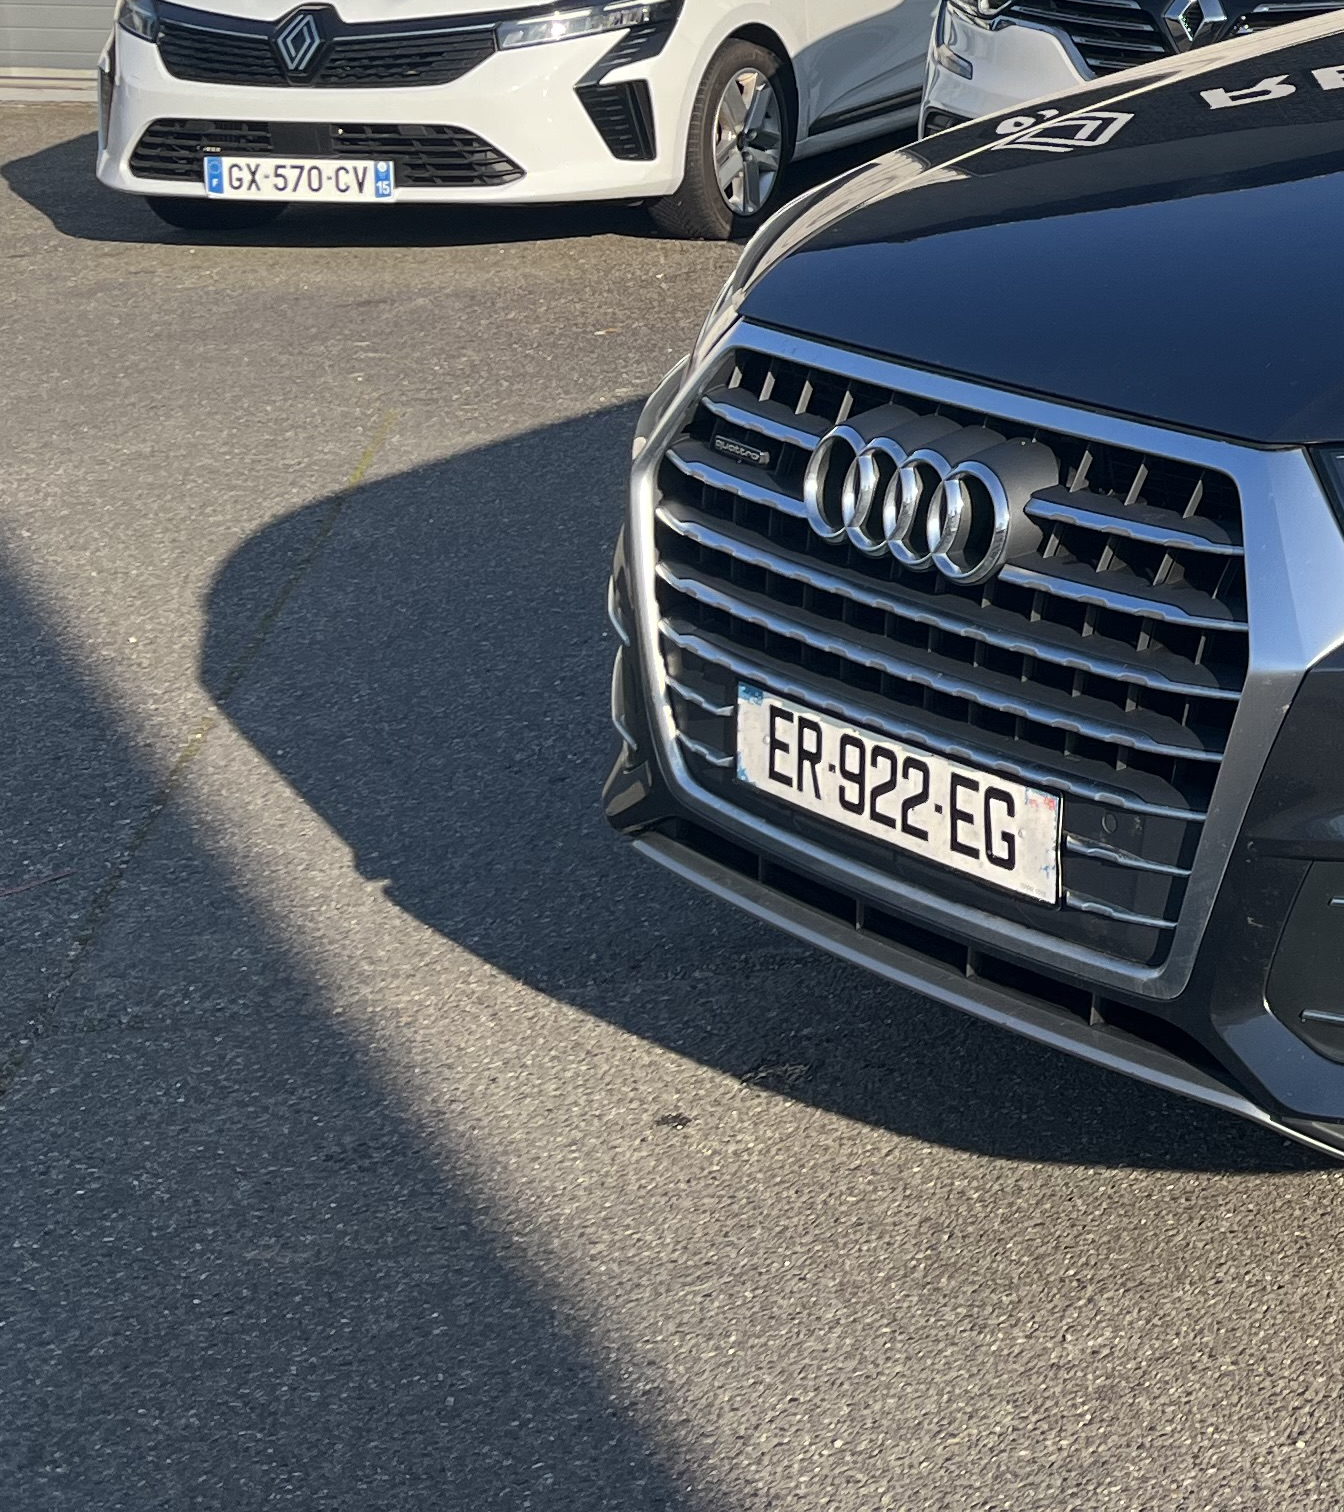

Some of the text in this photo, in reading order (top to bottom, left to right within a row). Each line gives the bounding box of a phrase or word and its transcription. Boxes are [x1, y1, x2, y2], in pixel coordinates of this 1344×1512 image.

[228, 163, 368, 194] GX-570-CV
[376, 180, 391, 196] 15
[715, 439, 760, 461] quattro
[768, 705, 1017, 870] ER-922-EG
